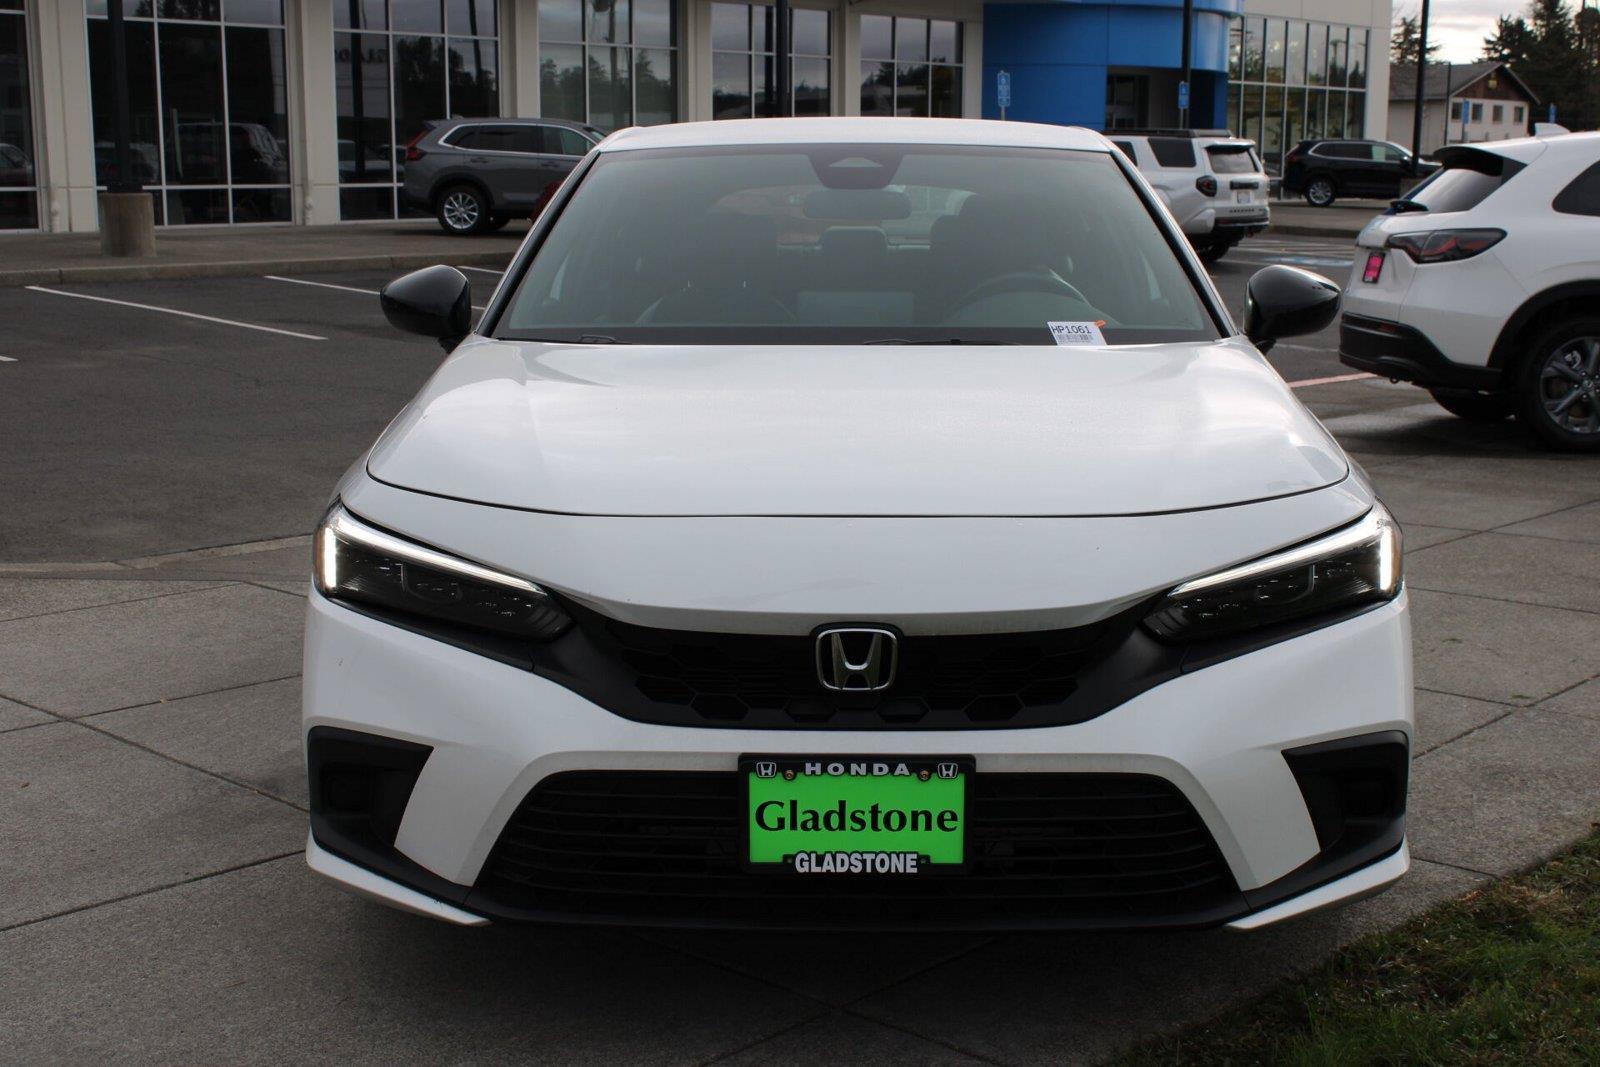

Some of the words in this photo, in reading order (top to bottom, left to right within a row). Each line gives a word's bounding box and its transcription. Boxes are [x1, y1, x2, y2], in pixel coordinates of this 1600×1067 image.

[1051, 325, 1092, 334] HP1061
[805, 763, 910, 776] HONDA
[755, 800, 958, 832] Gladstone
[795, 853, 918, 873] GLADSTONE
